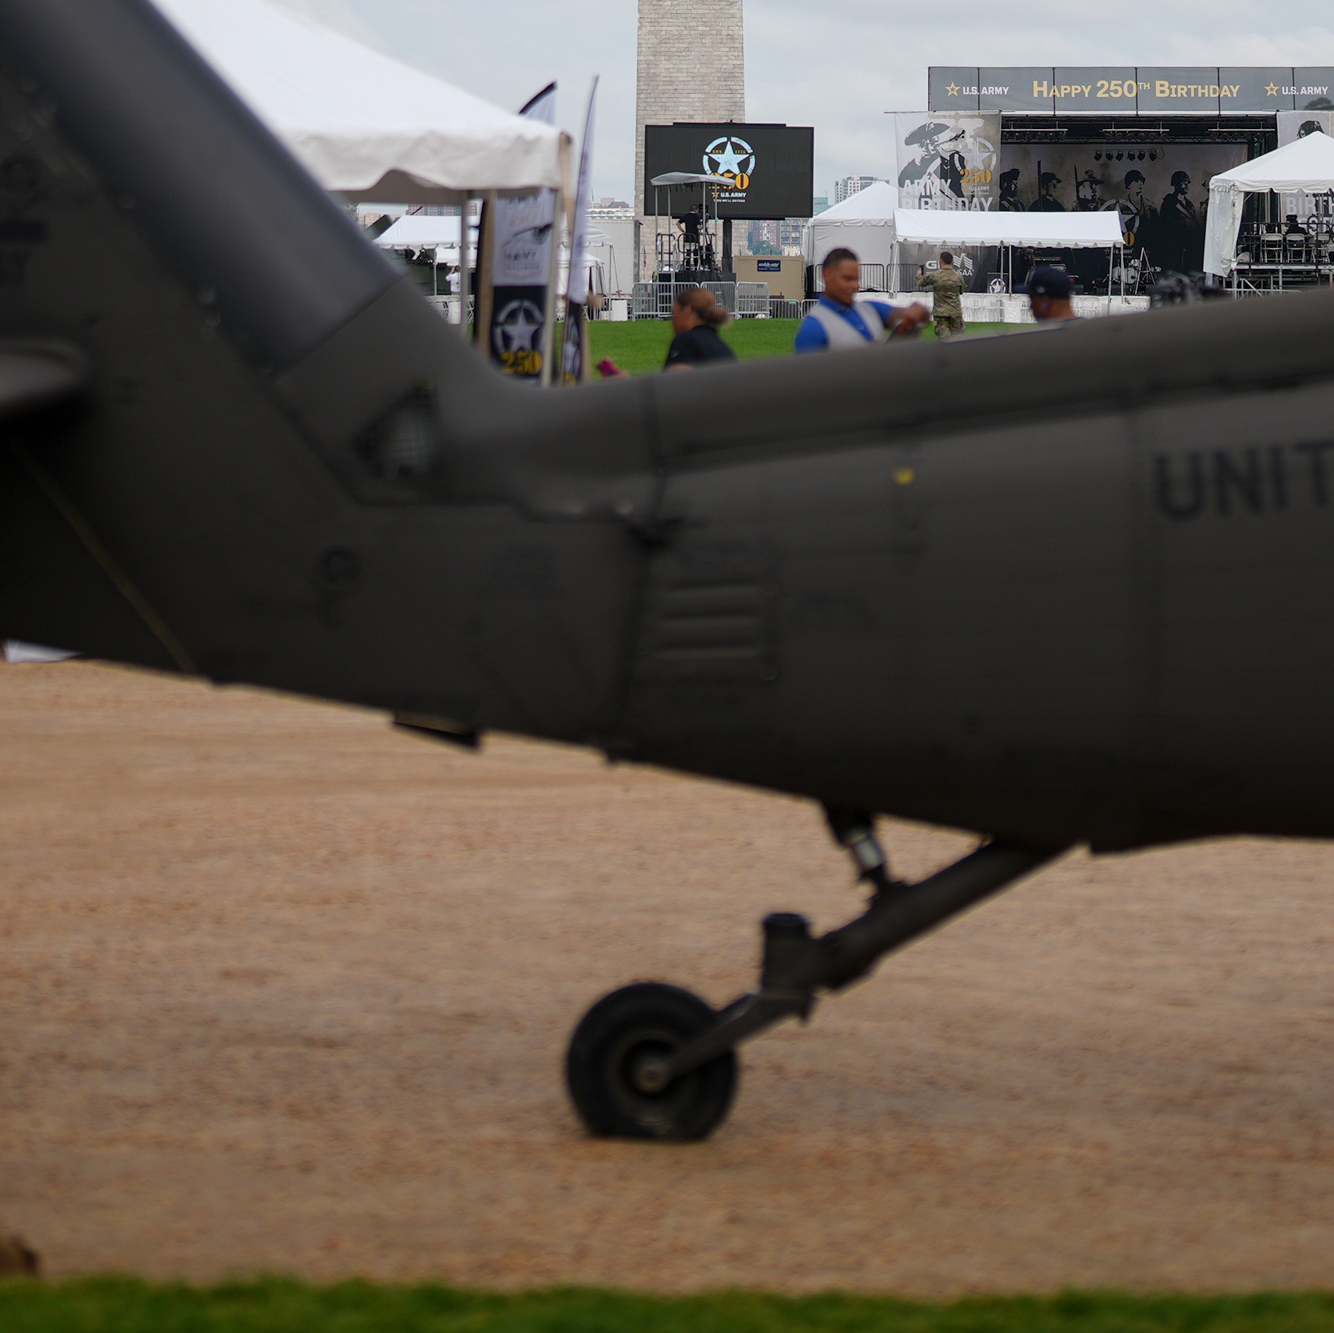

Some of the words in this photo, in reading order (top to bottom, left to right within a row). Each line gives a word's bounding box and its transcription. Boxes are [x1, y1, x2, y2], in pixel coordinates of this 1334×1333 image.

[963, 86, 980, 95] U.S.
[981, 86, 1010, 95] ARMY
[1282, 86, 1299, 95] U.S.
[1300, 86, 1329, 95] ARMY
[959, 168, 993, 184] 250
[902, 178, 952, 197] ARMY
